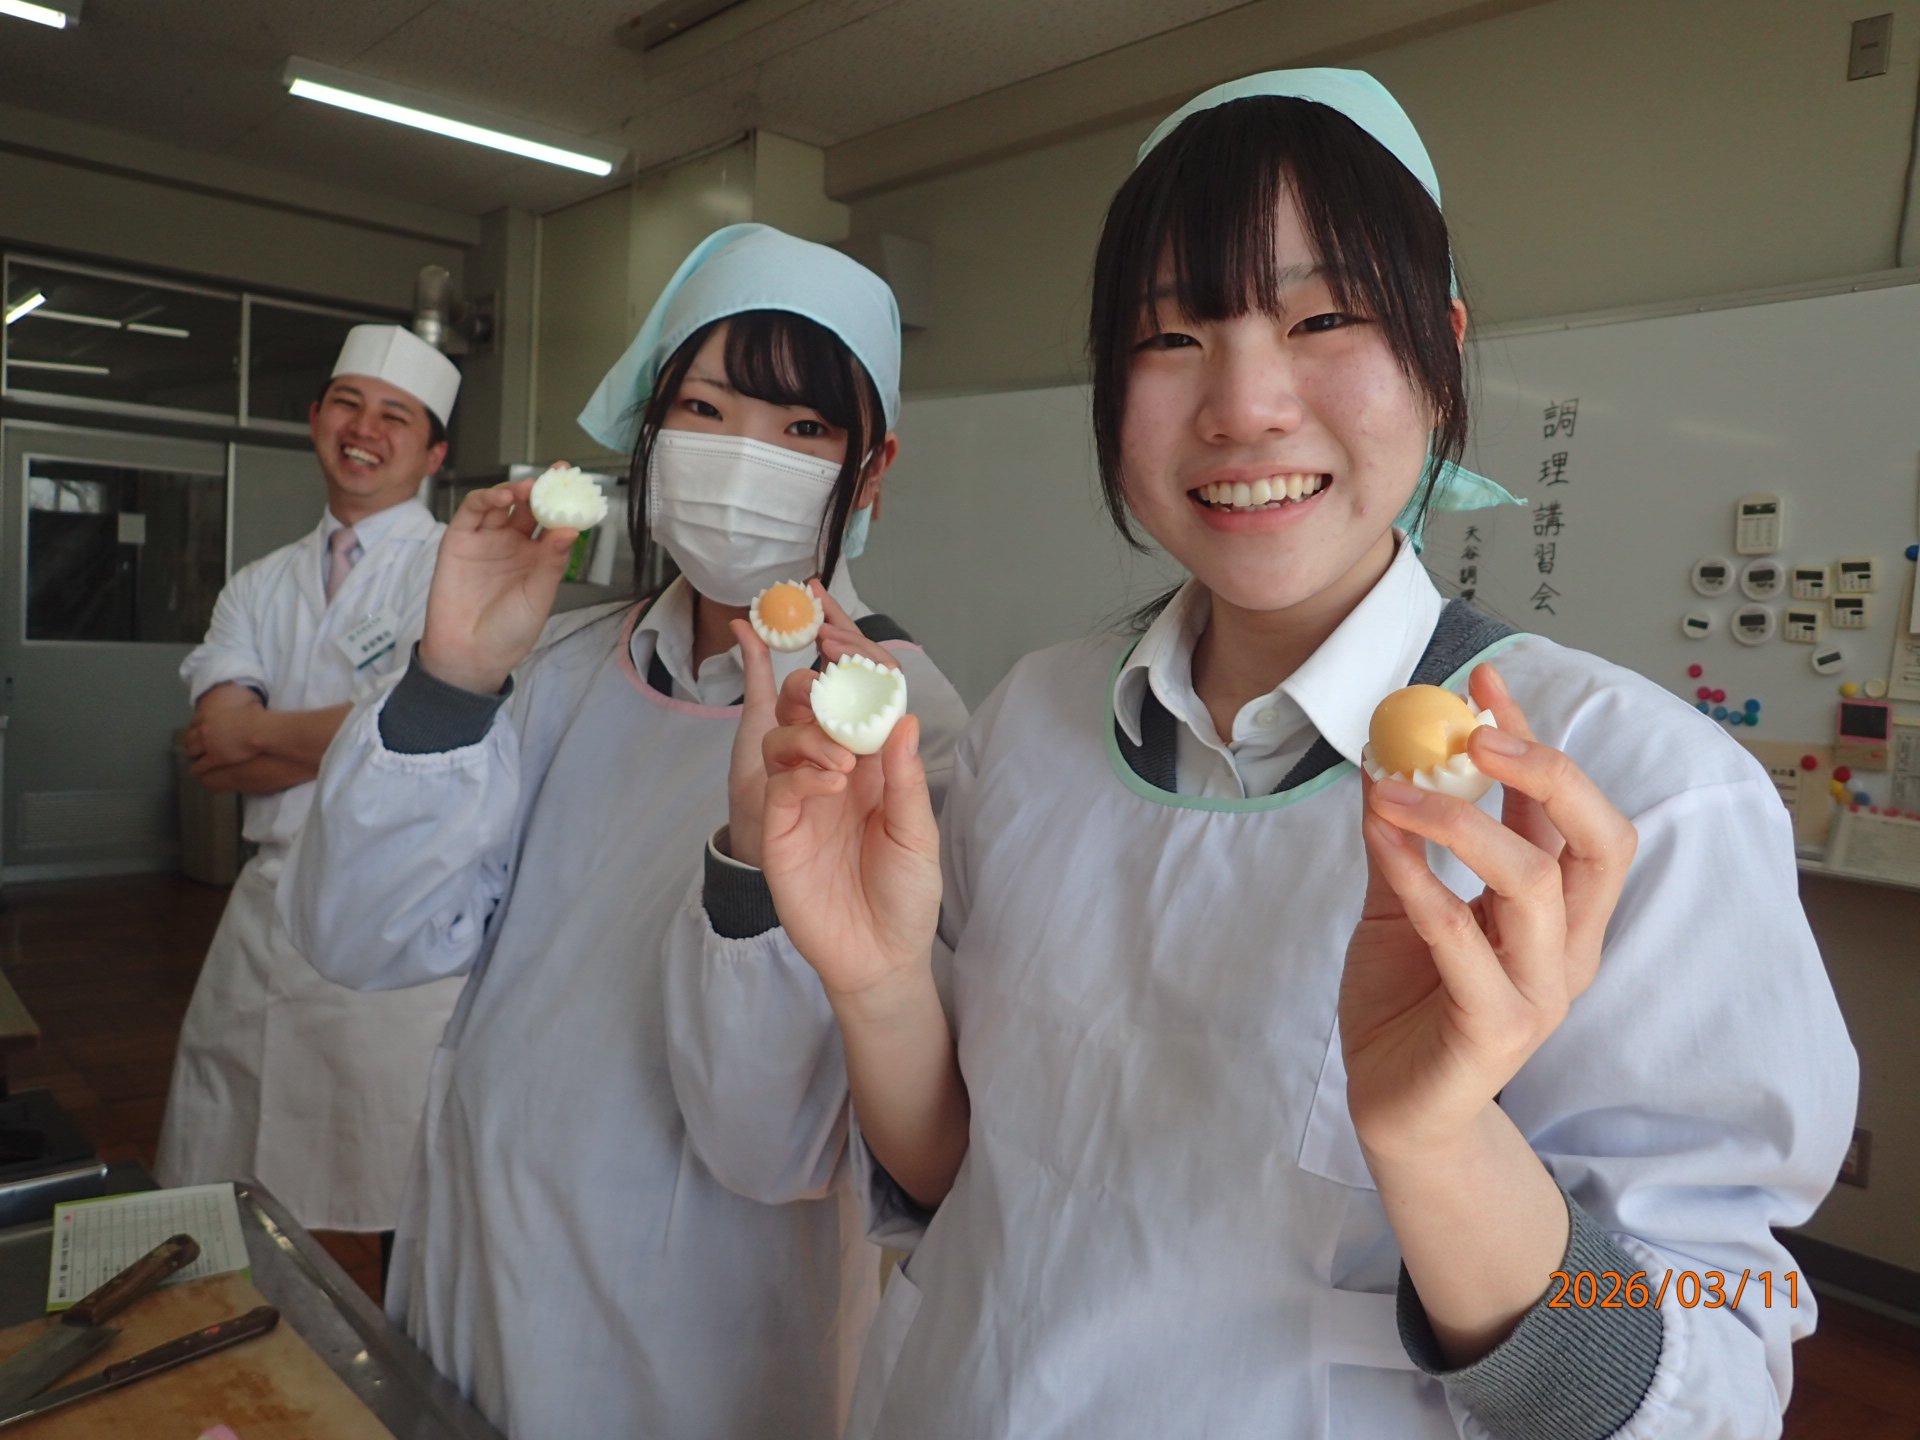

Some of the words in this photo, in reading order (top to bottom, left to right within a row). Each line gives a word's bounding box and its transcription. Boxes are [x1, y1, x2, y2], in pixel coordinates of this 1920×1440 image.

[1530, 398, 1579, 615] 調理講習会
